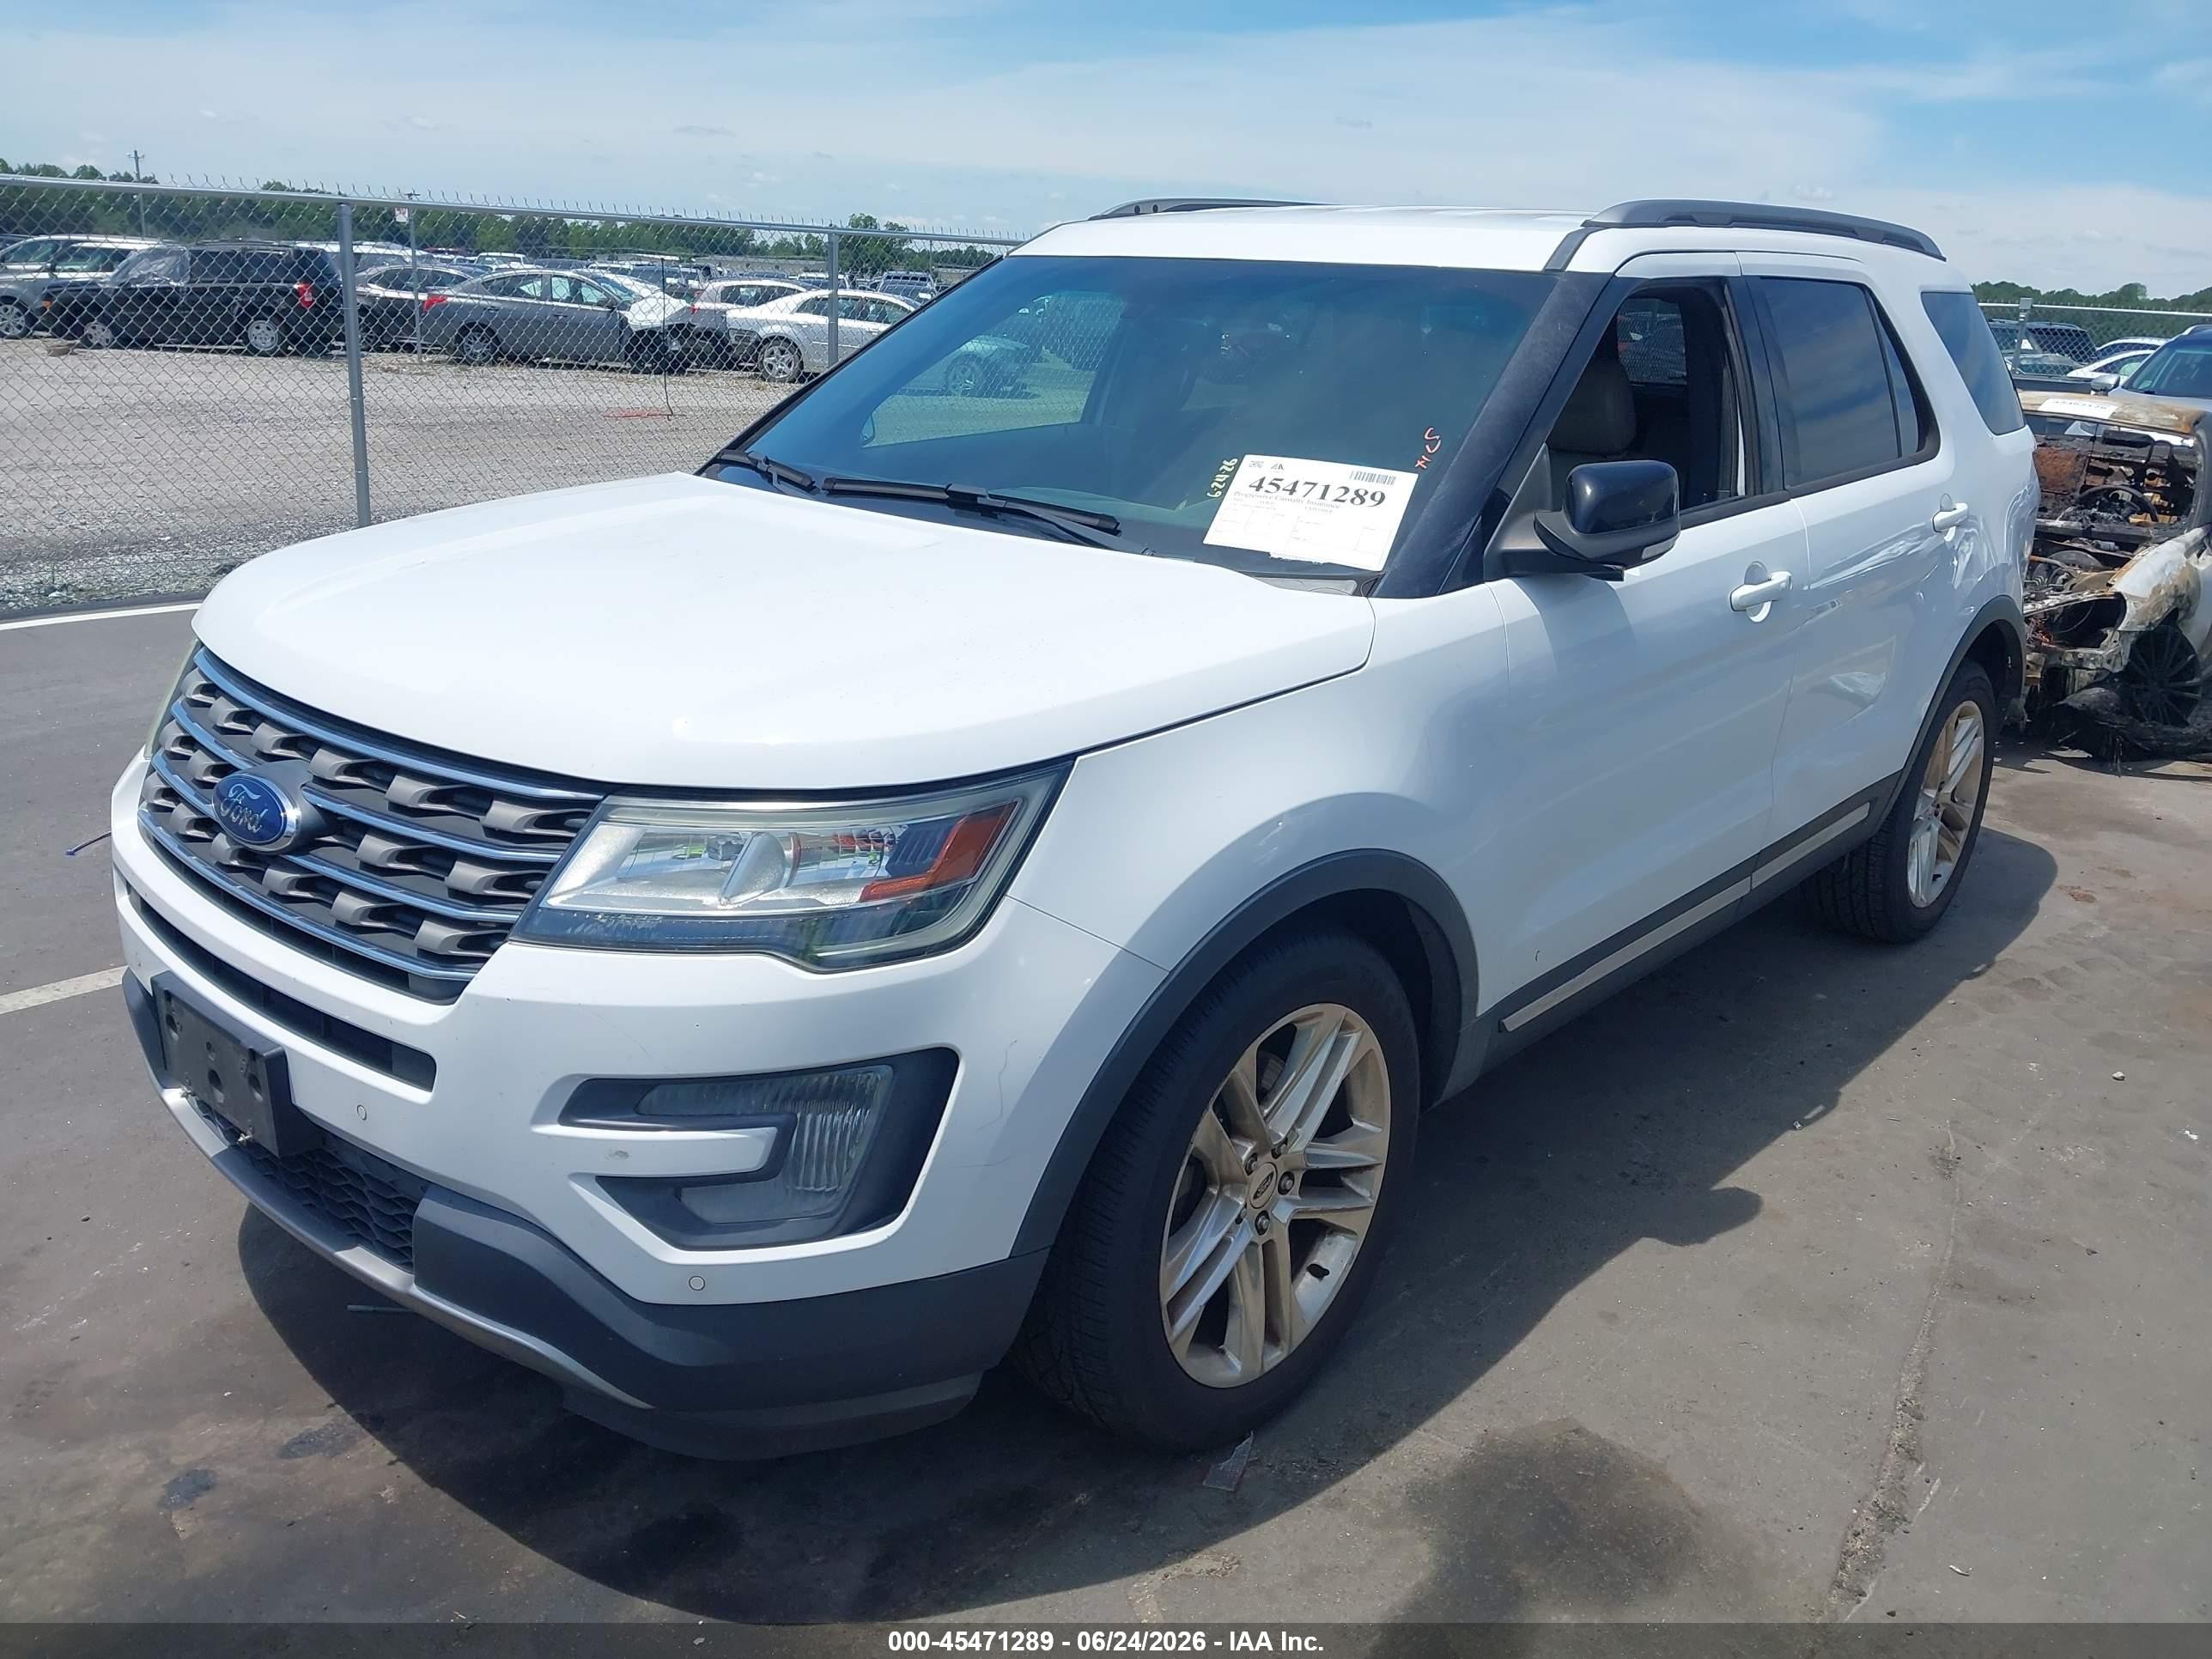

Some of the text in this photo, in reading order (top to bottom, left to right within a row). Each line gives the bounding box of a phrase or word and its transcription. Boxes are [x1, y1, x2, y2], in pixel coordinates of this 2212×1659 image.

[1206, 458, 1238, 497] 6-24-26
[1249, 476, 1386, 507] 45471289
[220, 783, 268, 833] Ford
